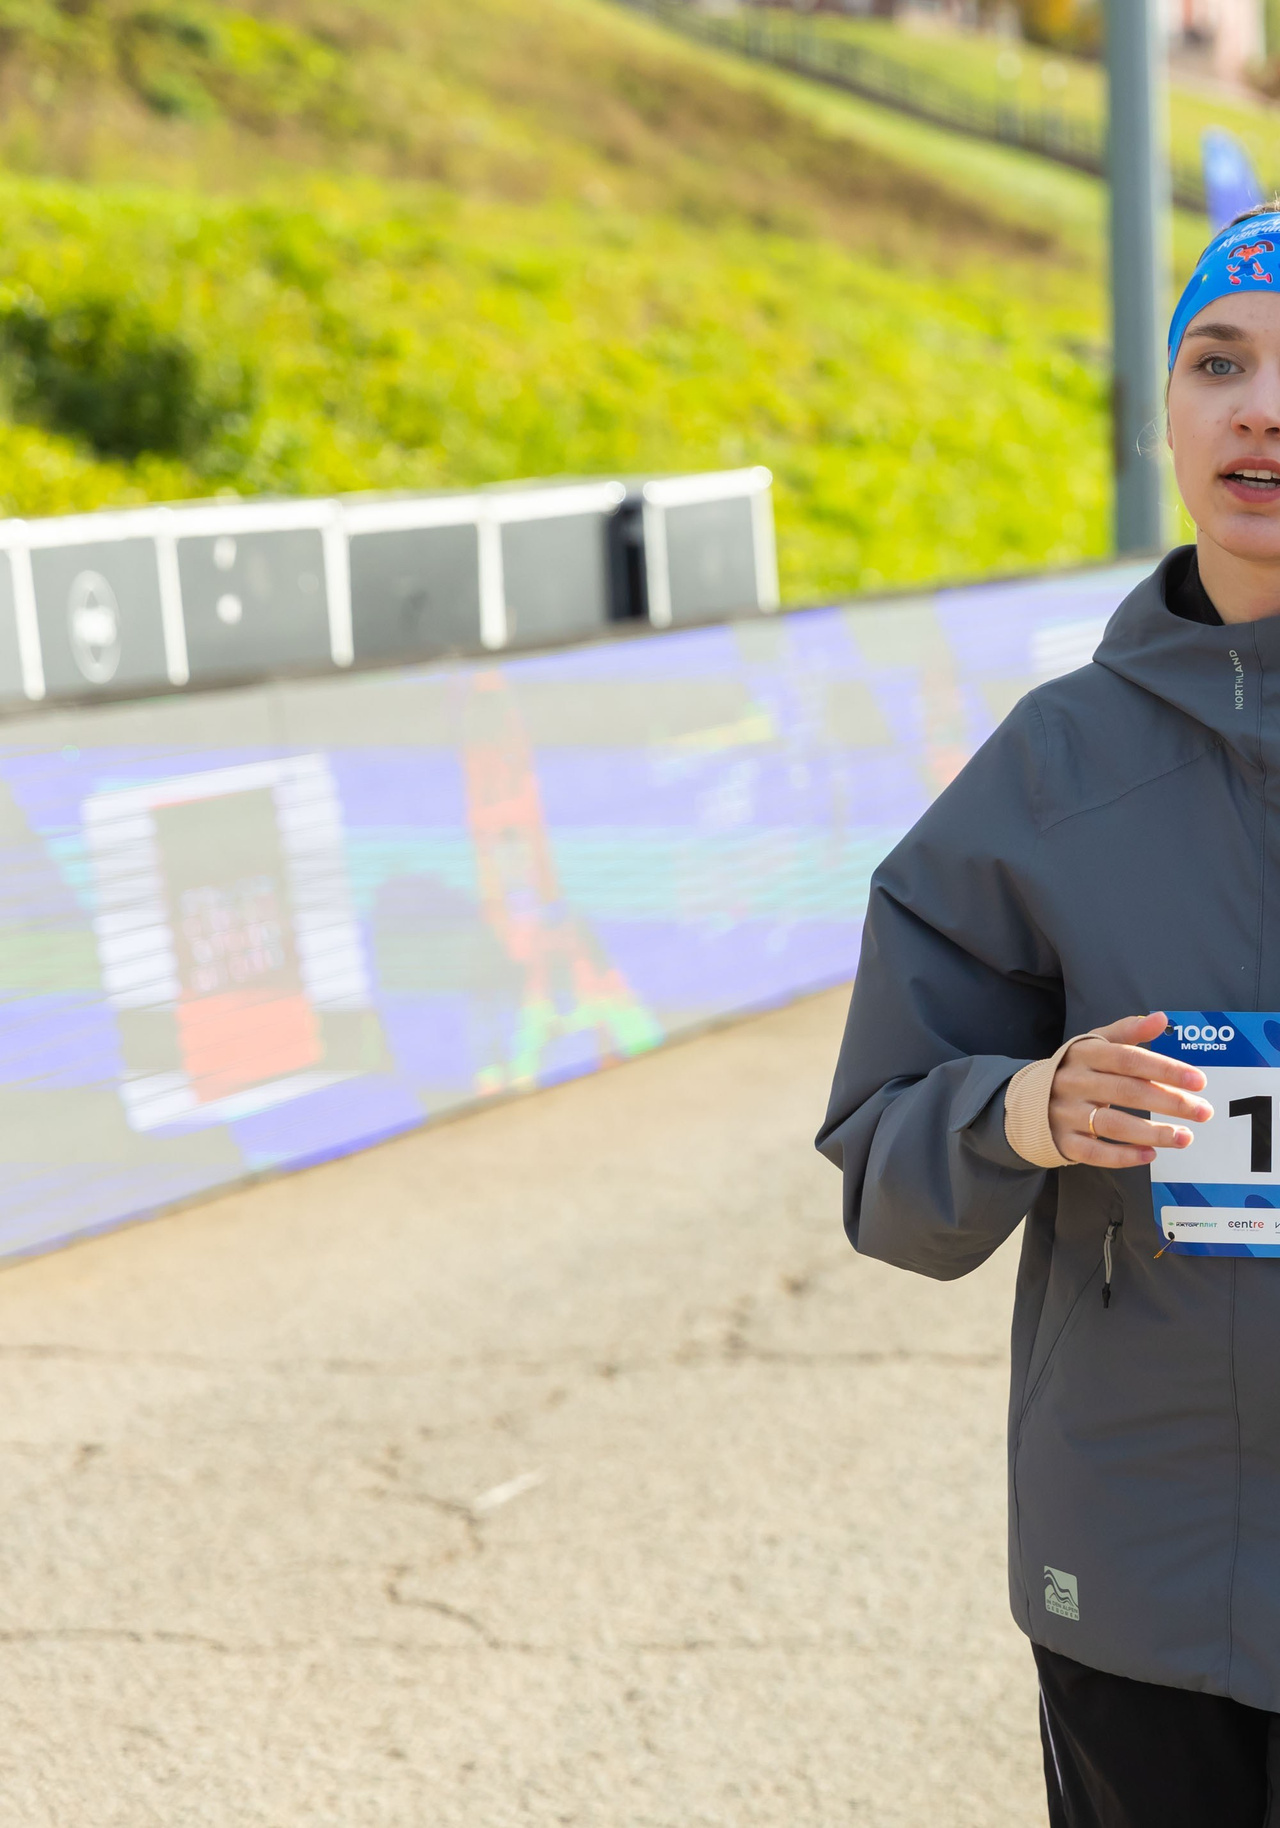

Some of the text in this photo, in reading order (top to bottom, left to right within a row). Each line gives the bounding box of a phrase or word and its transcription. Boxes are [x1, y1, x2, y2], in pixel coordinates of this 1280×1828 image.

[1229, 649, 1244, 710] NORTHLAND
[1173, 1024, 1235, 1042] 1000
[1181, 1042, 1227, 1052] метров
[1228, 1220, 1264, 1229] centre
